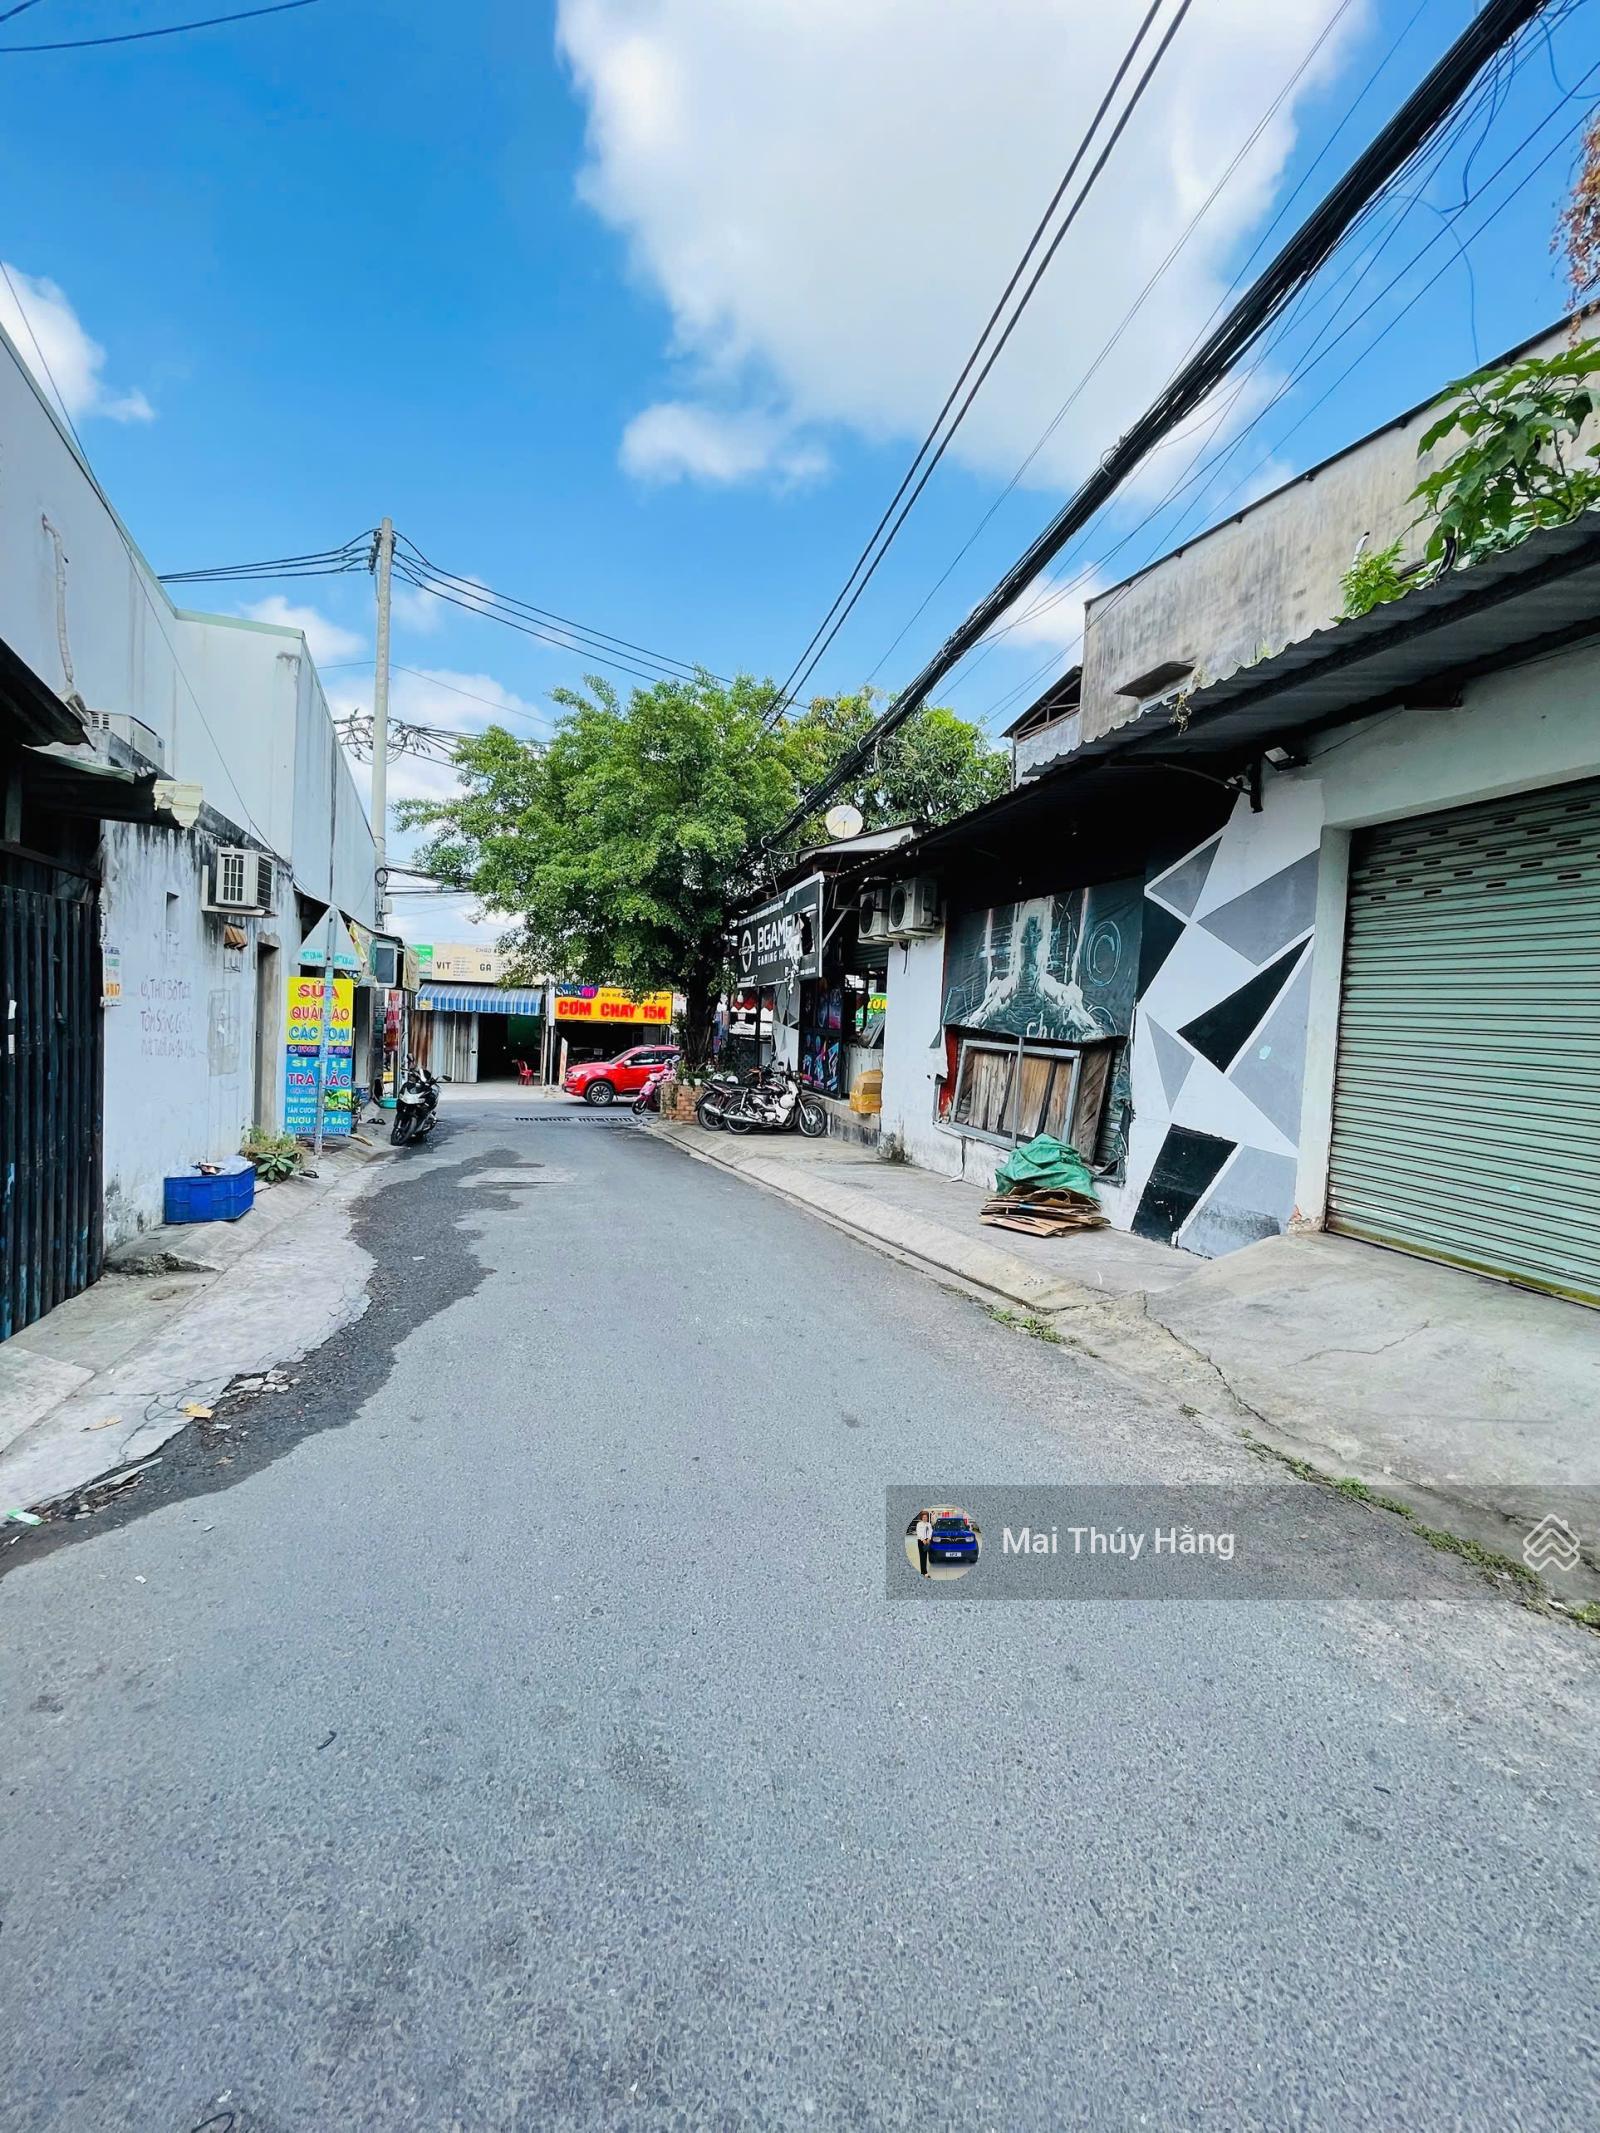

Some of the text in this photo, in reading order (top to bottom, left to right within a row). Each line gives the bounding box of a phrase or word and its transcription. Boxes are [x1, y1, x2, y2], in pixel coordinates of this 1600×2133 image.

[642, 1006, 667, 1020] 15K
[289, 1023, 350, 1045] CÁC OẠI
[288, 1070, 316, 1086] TRÀ
